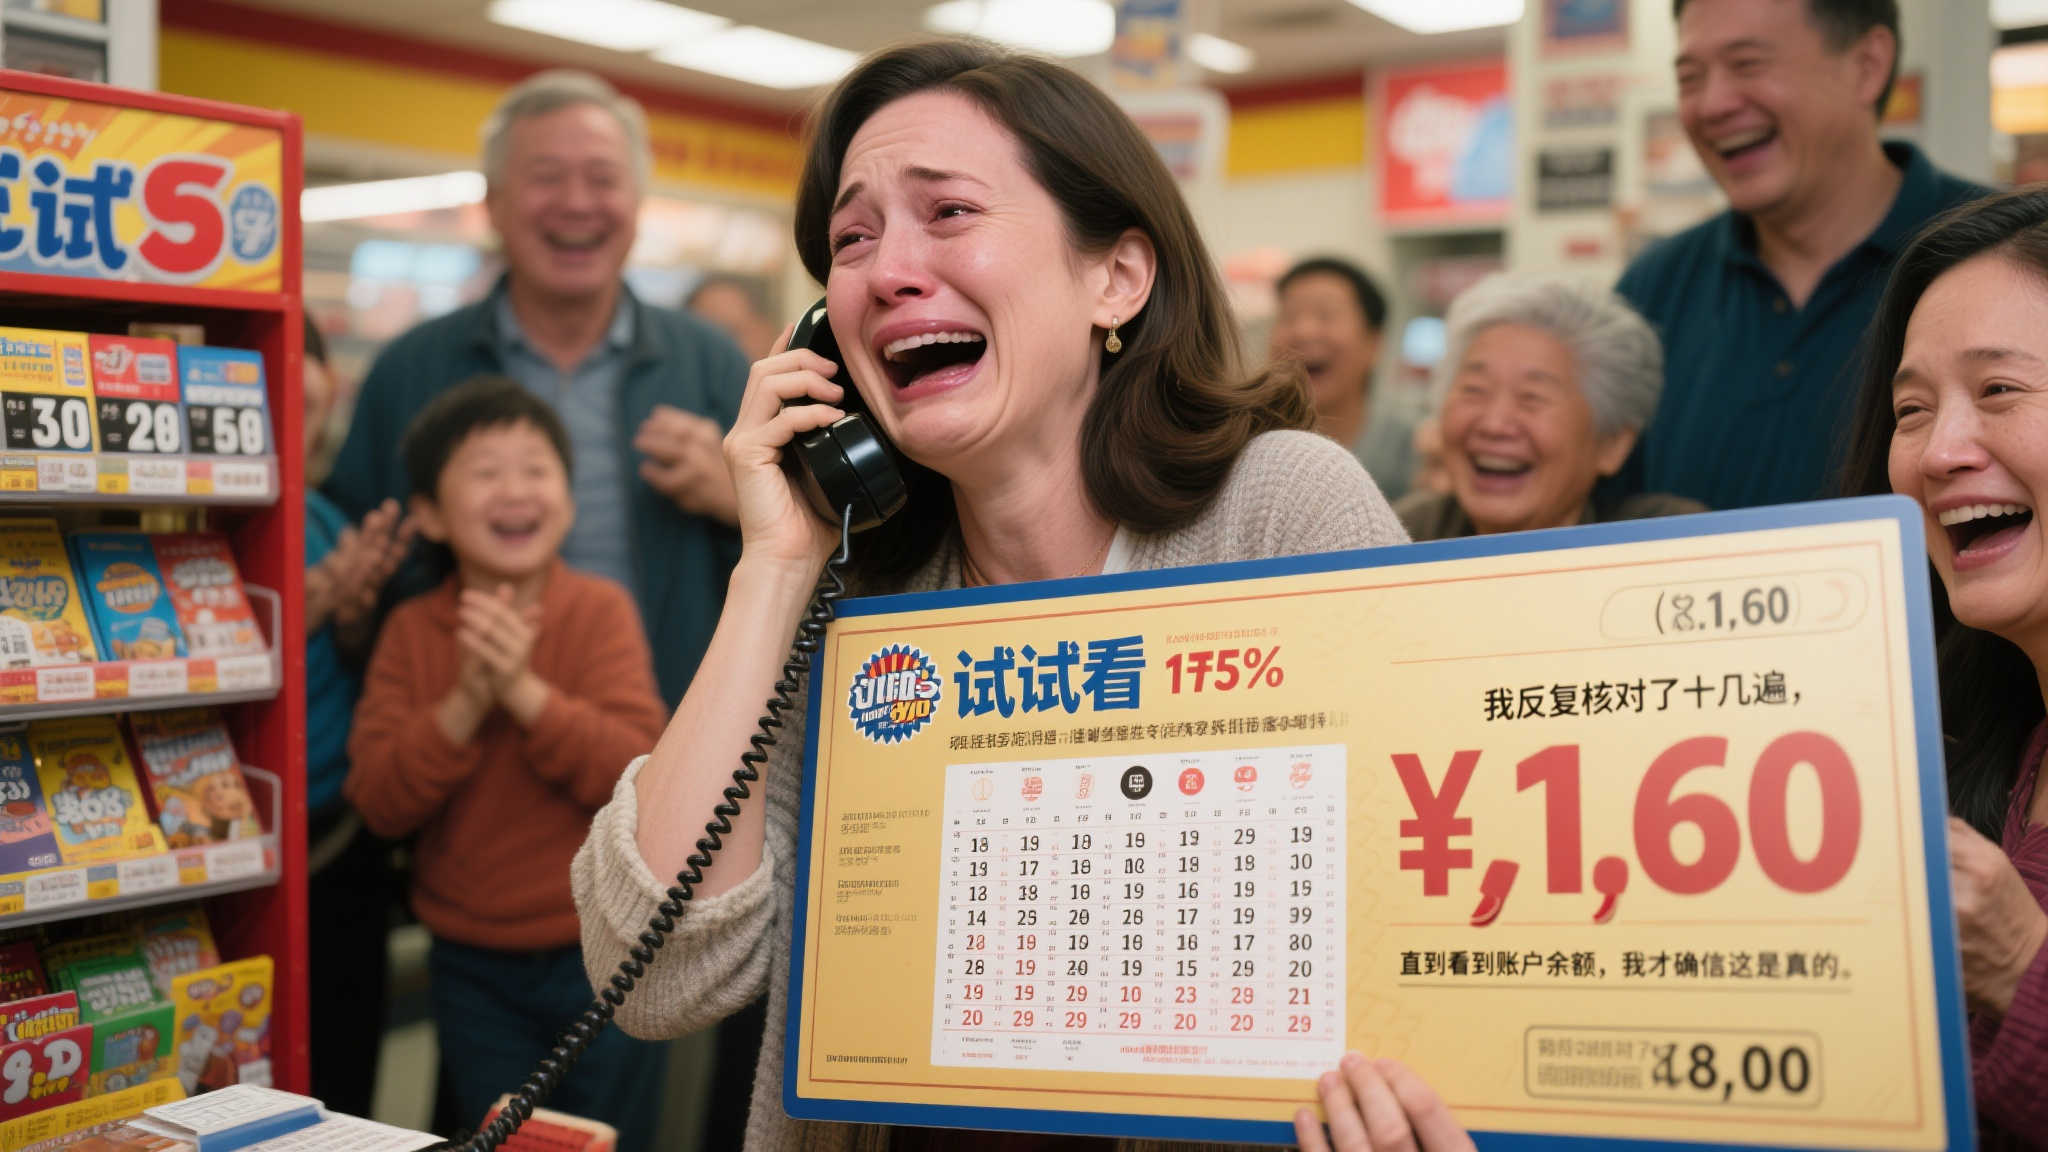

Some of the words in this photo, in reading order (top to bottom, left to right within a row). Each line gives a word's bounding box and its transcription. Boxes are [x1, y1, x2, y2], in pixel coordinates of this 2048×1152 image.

[31, 397, 91, 450] 30
[953, 634, 1147, 720] 试试看
[1233, 828, 1256, 845] 29
[1019, 860, 1039, 877] 17
[1123, 882, 1144, 900] 19
[1178, 881, 1199, 899] 16
[1234, 881, 1255, 898] 19
[967, 909, 987, 927] 14
[1177, 908, 1198, 925] 17
[1233, 907, 1255, 925] 19
[1234, 934, 1255, 951] 17
[1015, 959, 1036, 976] 19
[1121, 959, 1143, 977] 19
[1176, 959, 1198, 977] 15
[1288, 960, 1312, 978] 20
[1400, 949, 1853, 981] 直到看到账户余额，我才确信这是真的。
[1120, 985, 1142, 1003] 10
[1175, 986, 1197, 1004] 23
[1288, 987, 1310, 1005] 21
[962, 1009, 983, 1026] 20
[1065, 1011, 1087, 1029] 29
[1174, 1013, 1197, 1030] 20
